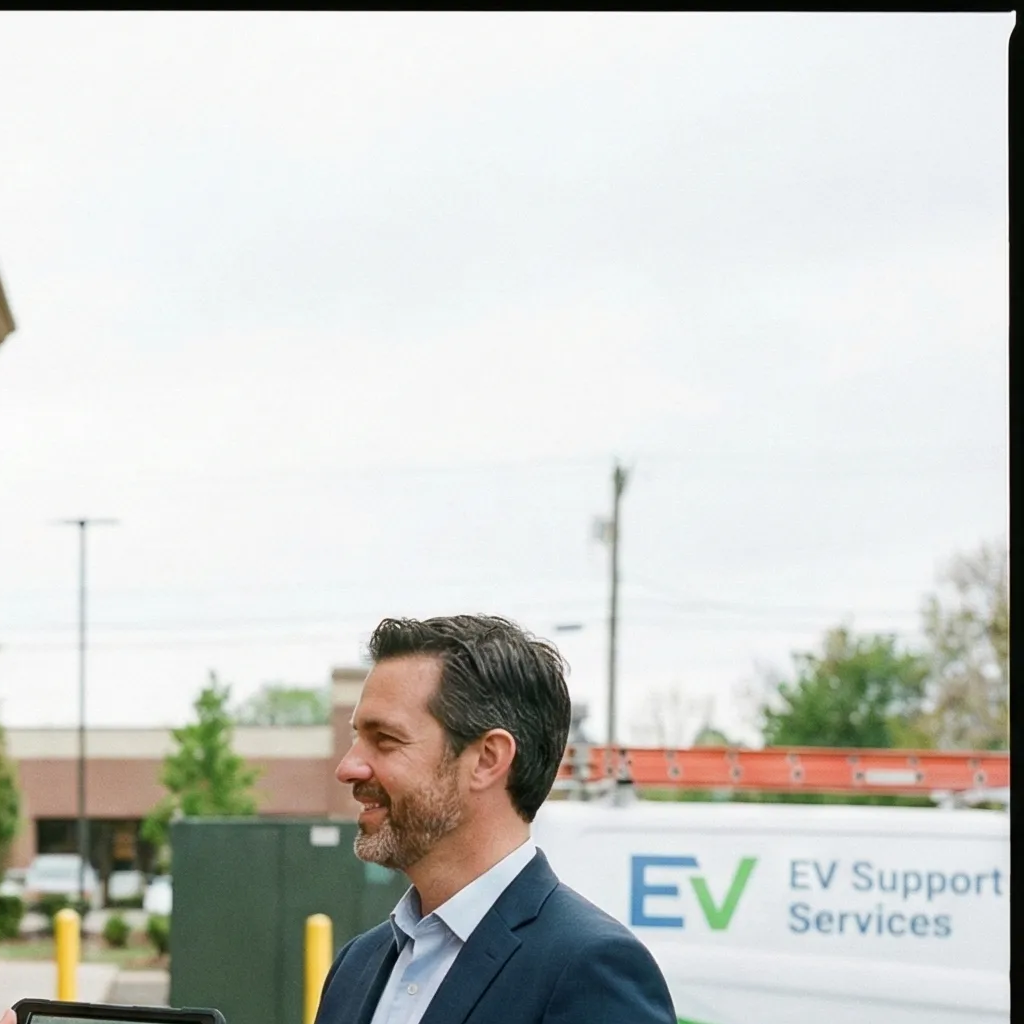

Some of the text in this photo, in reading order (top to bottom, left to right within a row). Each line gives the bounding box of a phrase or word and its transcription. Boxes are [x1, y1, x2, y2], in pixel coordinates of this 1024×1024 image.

[630, 855, 758, 931] EV
[788, 859, 1003, 900] EV Support
[788, 902, 952, 937] Services
